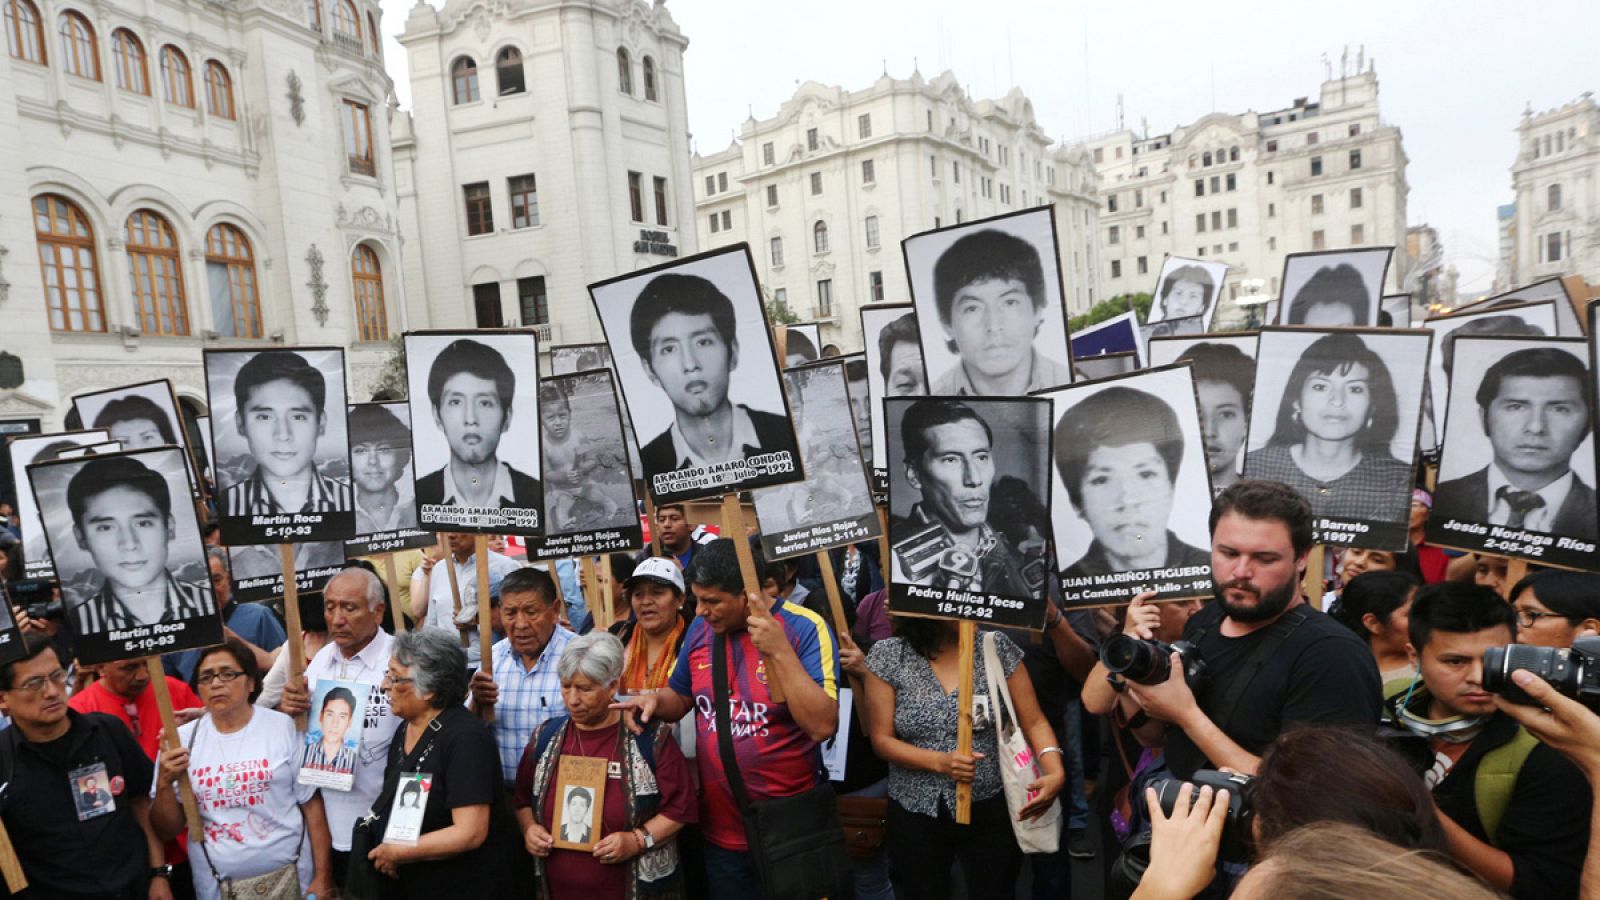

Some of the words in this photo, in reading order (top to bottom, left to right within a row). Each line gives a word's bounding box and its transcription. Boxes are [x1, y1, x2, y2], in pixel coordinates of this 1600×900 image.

[654, 468, 705, 484] ARMANDO
[708, 461, 745, 474] AMARO
[670, 479, 709, 491] Cantuta
[734, 469, 757, 480] Julio
[768, 463, 793, 474] 1992
[421, 504, 466, 515] ARMANDO
[467, 507, 499, 516] AMARO
[293, 514, 322, 523] Roca
[434, 513, 467, 523] Cantuta
[488, 517, 508, 525] Julio
[516, 517, 538, 527] 1992
[1320, 520, 1369, 532] Barreto
[265, 526, 312, 537] 5-10-93
[372, 532, 397, 541] Alfaro
[545, 536, 572, 546] Javier
[595, 531, 620, 540] Rojas
[783, 530, 810, 543] Javier
[832, 521, 858, 532] Rojas
[1323, 531, 1356, 543] 1997
[1443, 520, 1487, 535] Jesús
[1490, 527, 1553, 546] Noriega
[368, 540, 404, 551] 10-10-91
[537, 546, 569, 556] Barrios
[571, 543, 594, 553] Altos
[596, 539, 630, 550] 3-11-91
[775, 541, 809, 554] Barrios
[810, 537, 832, 547] Altos
[834, 527, 869, 541] 3-11-91
[1484, 538, 1544, 557] 2-05-92
[239, 578, 275, 589] Melissa
[1063, 578, 1092, 588] JUAN
[1095, 570, 1151, 585] MARIÑOS
[908, 586, 943, 599] Pedro
[946, 590, 984, 604] Huilca
[988, 595, 1025, 609] Tecse
[1065, 591, 1080, 600] La
[1082, 587, 1129, 599] Cantuta
[1153, 584, 1181, 593] Julio
[937, 603, 993, 618] 18-12-92
[153, 622, 185, 634] Roca
[125, 635, 176, 651] 5-10-93
[696, 695, 768, 724] QTAR
[219, 758, 269, 773] ASESINO
[199, 776, 221, 789] POR
[217, 781, 271, 797] REGRESE
[213, 795, 264, 811] PRISION
